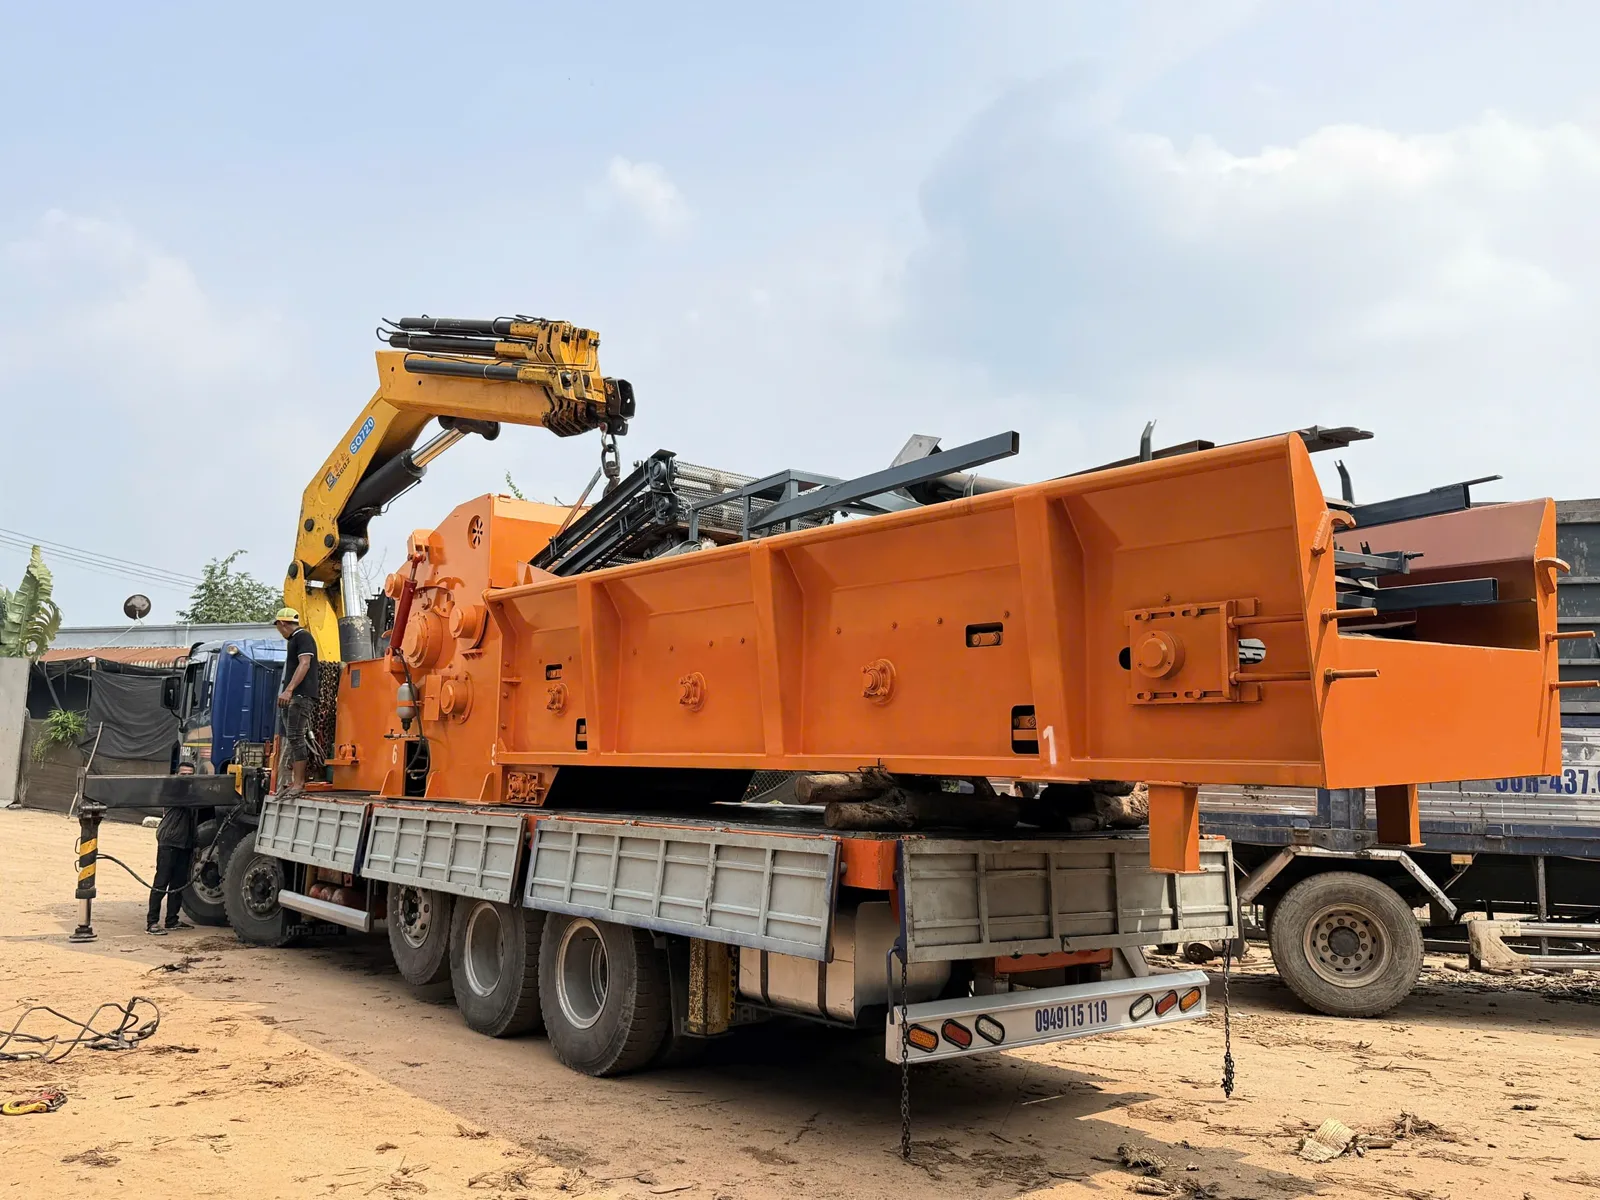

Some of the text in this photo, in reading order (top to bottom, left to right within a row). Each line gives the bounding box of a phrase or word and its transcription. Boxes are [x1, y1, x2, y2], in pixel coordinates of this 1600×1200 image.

[350, 417, 375, 453] SQ720
[1043, 725, 1057, 765] 1
[1088, 1000, 1107, 1024] 119
